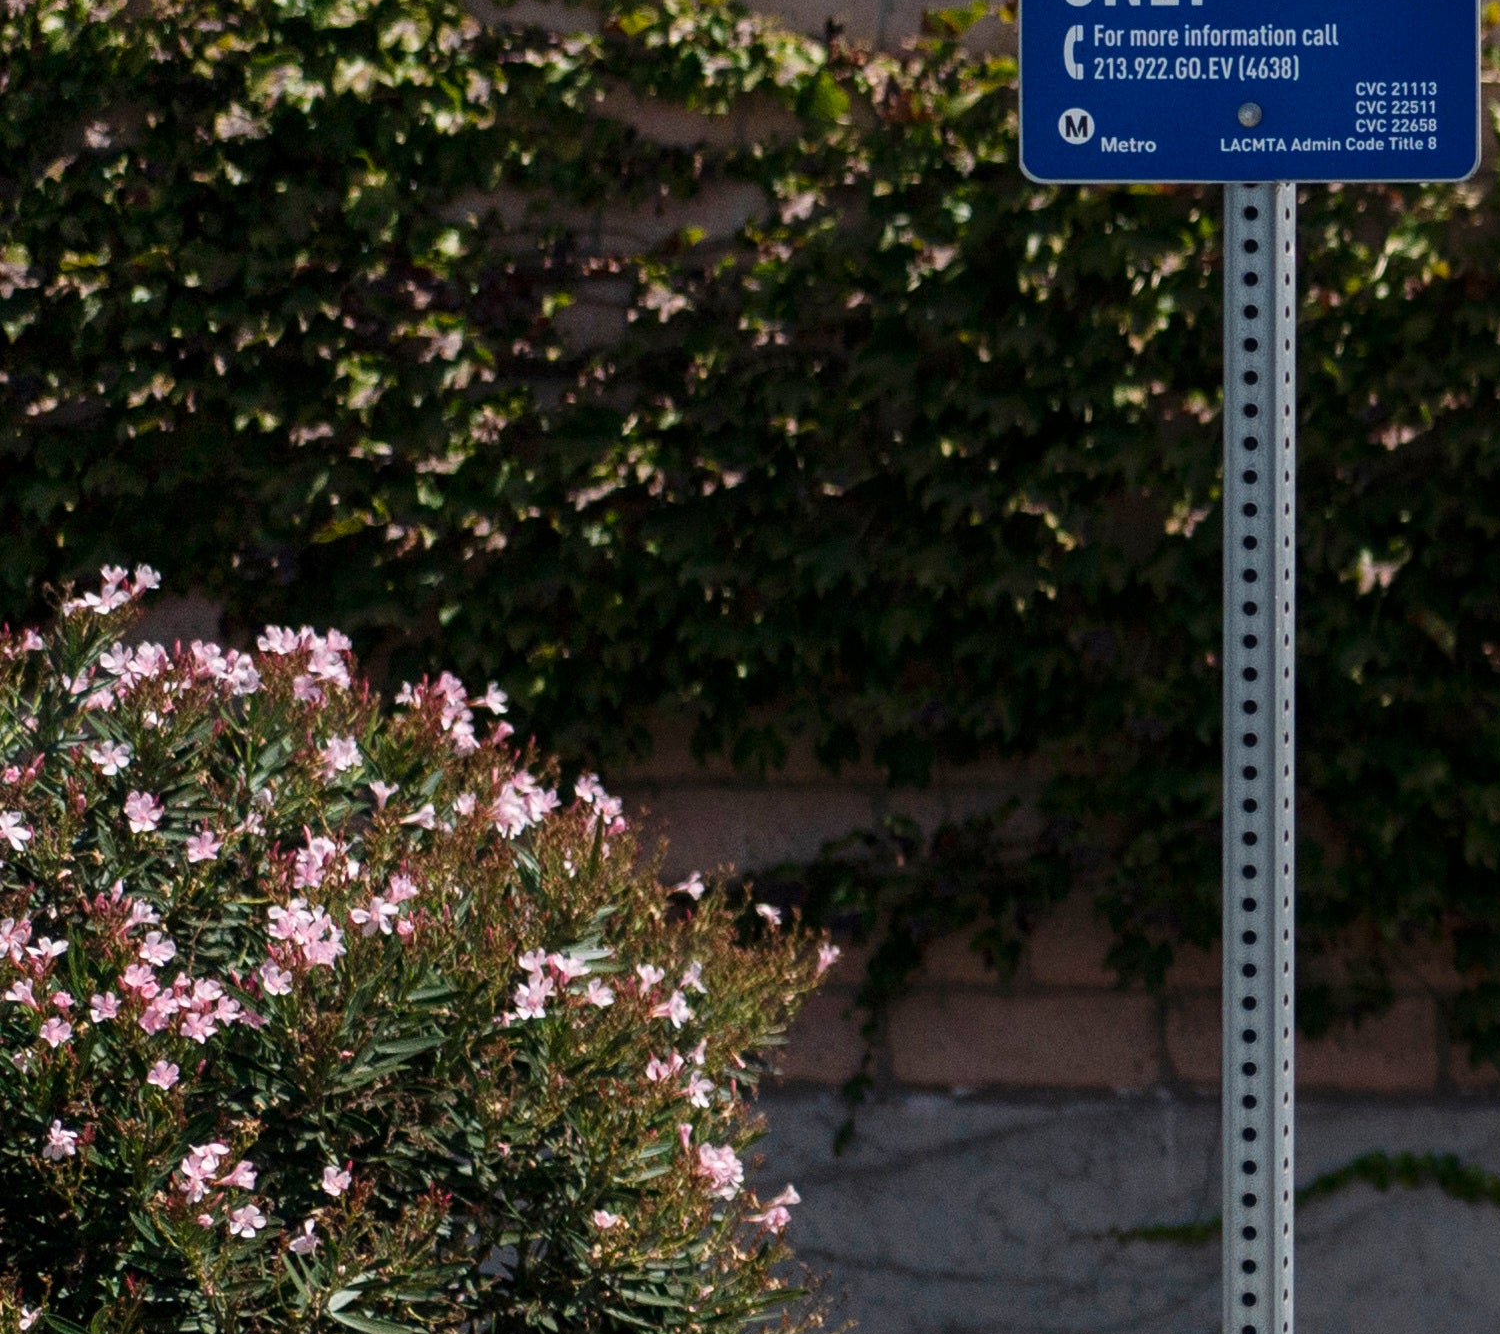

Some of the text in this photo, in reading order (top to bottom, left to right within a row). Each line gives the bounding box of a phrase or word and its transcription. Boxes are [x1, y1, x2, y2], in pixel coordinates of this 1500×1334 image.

[1094, 24, 1339, 47] For more information call
[1094, 55, 1299, 81] 213.922.GO.EV (4638)
[1355, 82, 1437, 96] CVC 21113
[1355, 100, 1436, 115] CVC 22511
[1355, 118, 1437, 133] CVC 22658
[1101, 137, 1157, 153] Metro
[1220, 136, 1437, 152] LACMTA Admin Code Title 8
